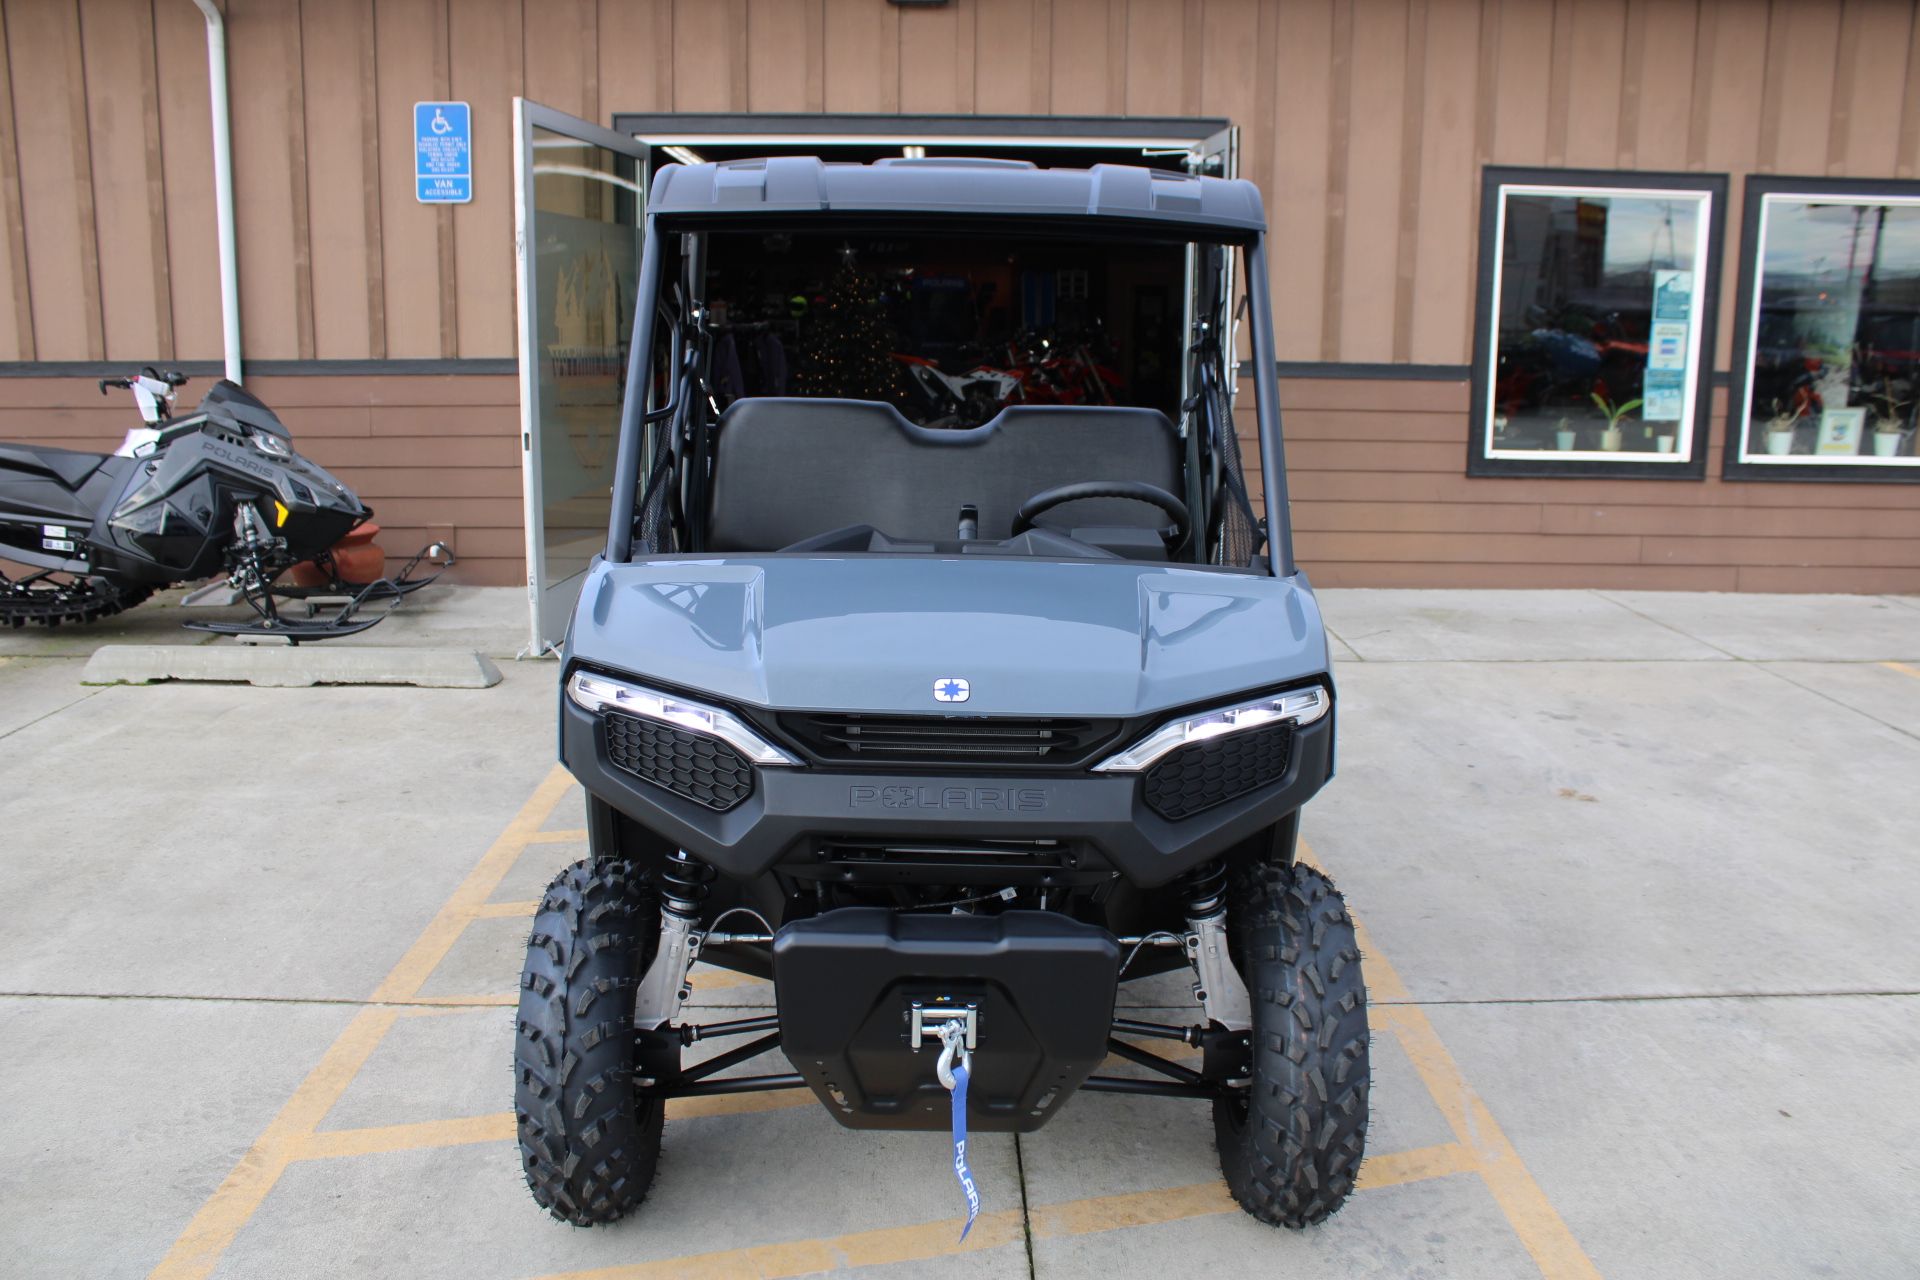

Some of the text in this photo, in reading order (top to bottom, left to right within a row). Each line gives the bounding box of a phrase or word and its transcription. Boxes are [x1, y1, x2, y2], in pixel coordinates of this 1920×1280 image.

[434, 179, 453, 188] VAN
[202, 442, 274, 478] POLARIS
[849, 785, 1048, 812] POLARIS
